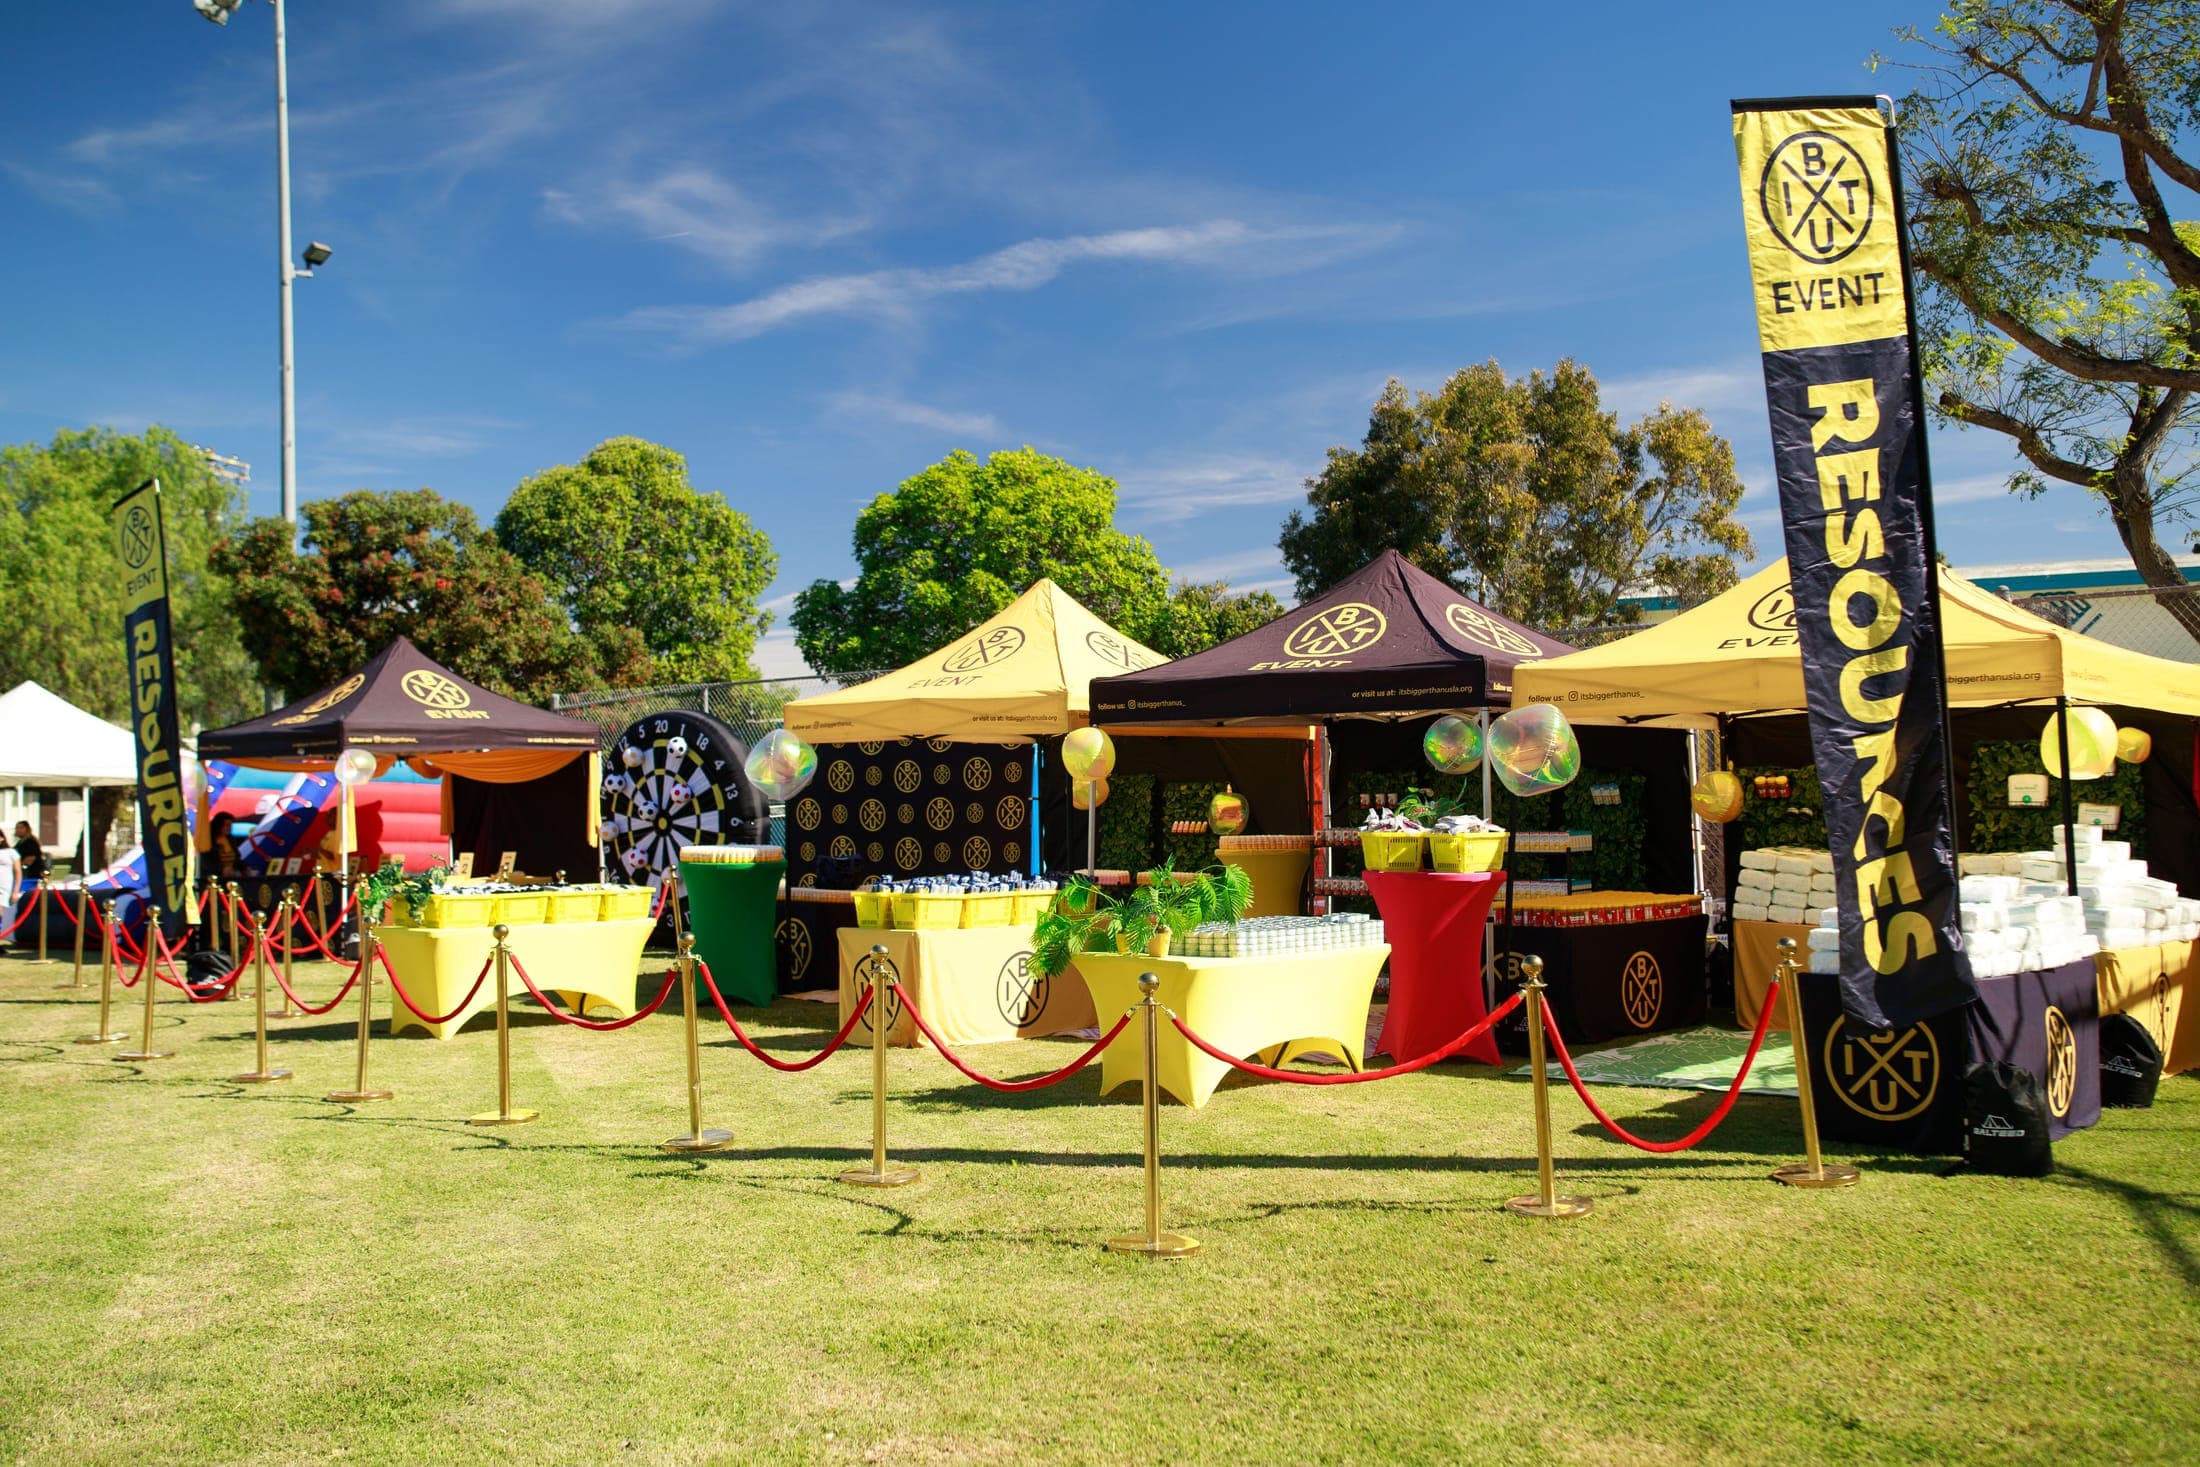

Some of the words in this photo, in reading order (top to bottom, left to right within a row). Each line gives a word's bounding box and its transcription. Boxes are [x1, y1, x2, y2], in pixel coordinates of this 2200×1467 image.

[1771, 271, 1885, 315] EVENT
[1717, 636, 1799, 650] EVE
[1248, 659, 1352, 671] EVENT
[908, 675, 983, 689] EVENT
[1806, 377, 1937, 976] RESOURCES
[1946, 672, 2041, 685] biggerthanusla.org
[1361, 689, 1375, 698] visit
[1528, 694, 1552, 703] follow
[1553, 694, 1565, 702] us:
[424, 709, 490, 719] EVENT
[638, 724, 646, 738] 5
[655, 719, 669, 734] 20
[680, 722, 686, 737] 1
[618, 736, 630, 751] 12
[697, 732, 707, 750] 18
[714, 759, 725, 771] 4
[724, 782, 740, 800] 13
[730, 816, 741, 828] 6
[666, 914, 674, 928] 3
